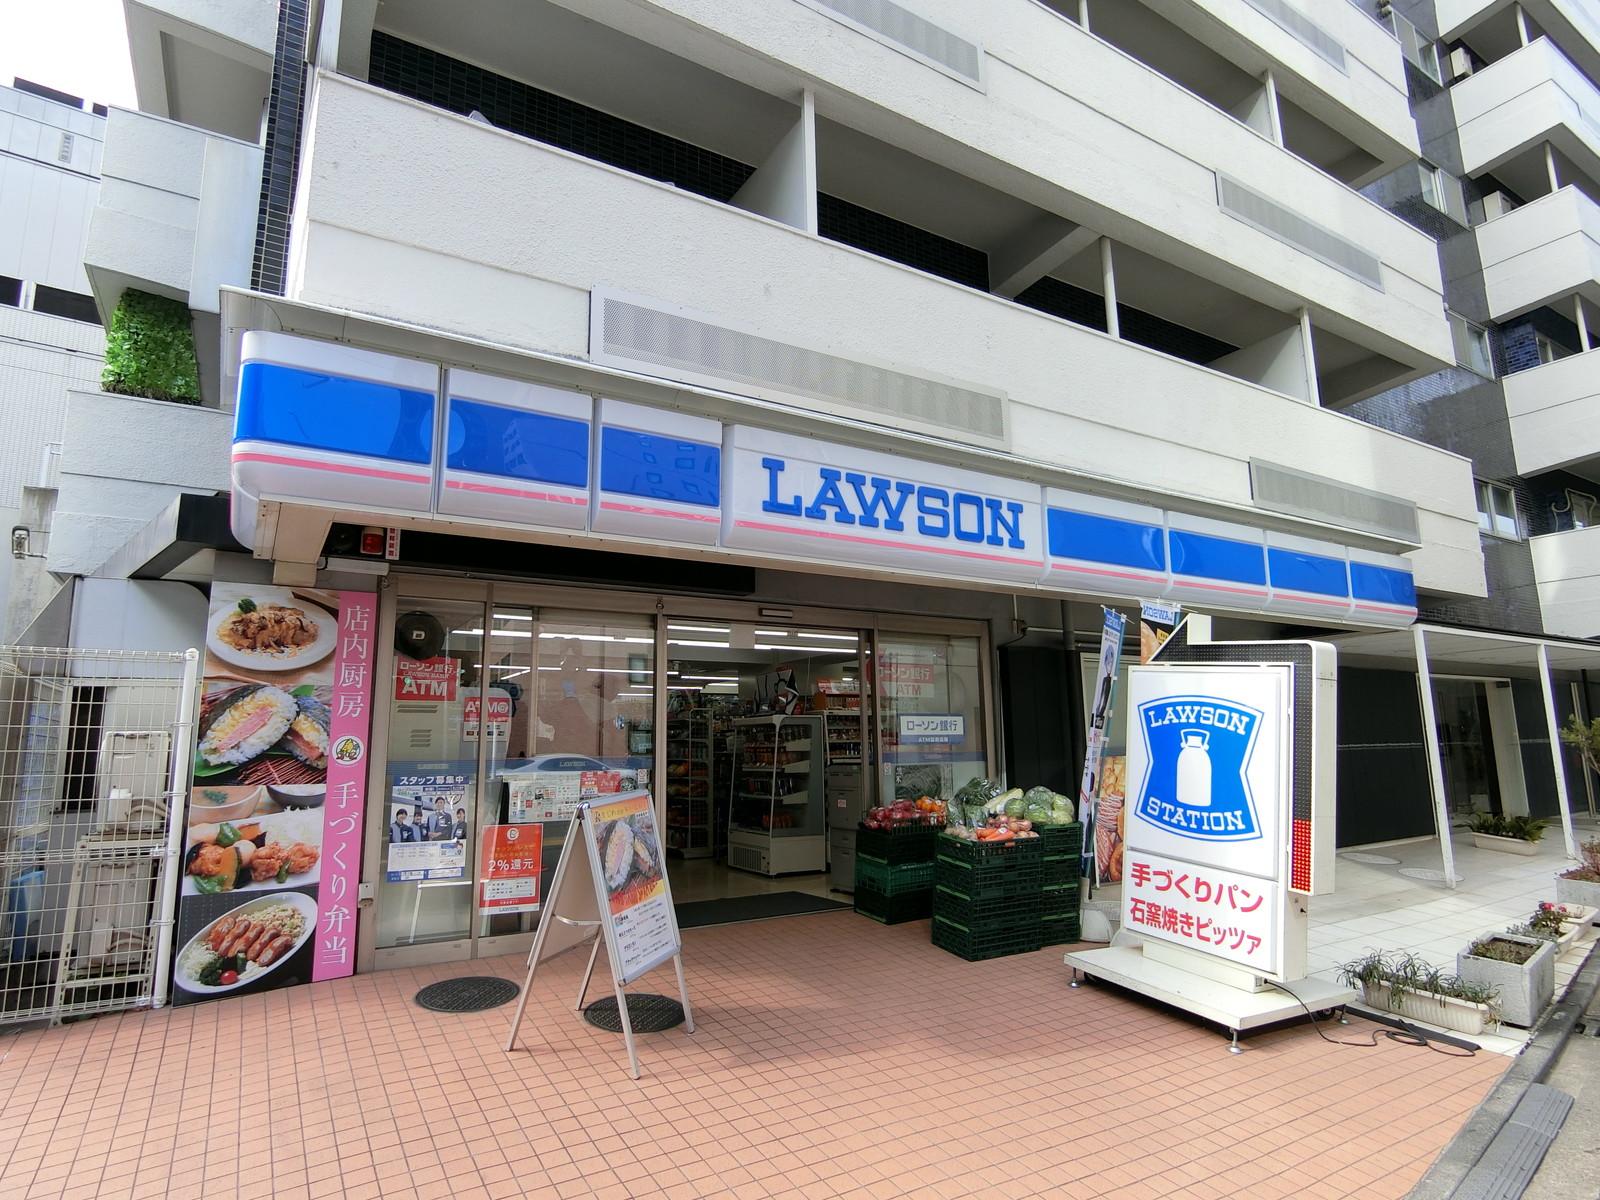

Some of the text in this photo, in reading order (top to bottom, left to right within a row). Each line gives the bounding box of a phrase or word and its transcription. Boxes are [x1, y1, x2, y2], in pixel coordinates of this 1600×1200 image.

[761, 457, 1025, 550] LAWSON
[337, 605, 371, 719] 店内厨房
[400, 661, 454, 674] ローソン銀行
[402, 680, 448, 697] ATM
[897, 684, 922, 696] ATM
[906, 719, 958, 732] ローソン銀行
[1148, 705, 1250, 735] LAWSON
[399, 775, 464, 785] スタッフ募集中
[1147, 796, 1247, 832] STATION
[320, 781, 359, 966] 手づくり弁当
[488, 858, 534, 872] 2%還元
[1130, 861, 1264, 914] 手づくりパン
[1129, 896, 1262, 956] 石窯焼きピッツァ
